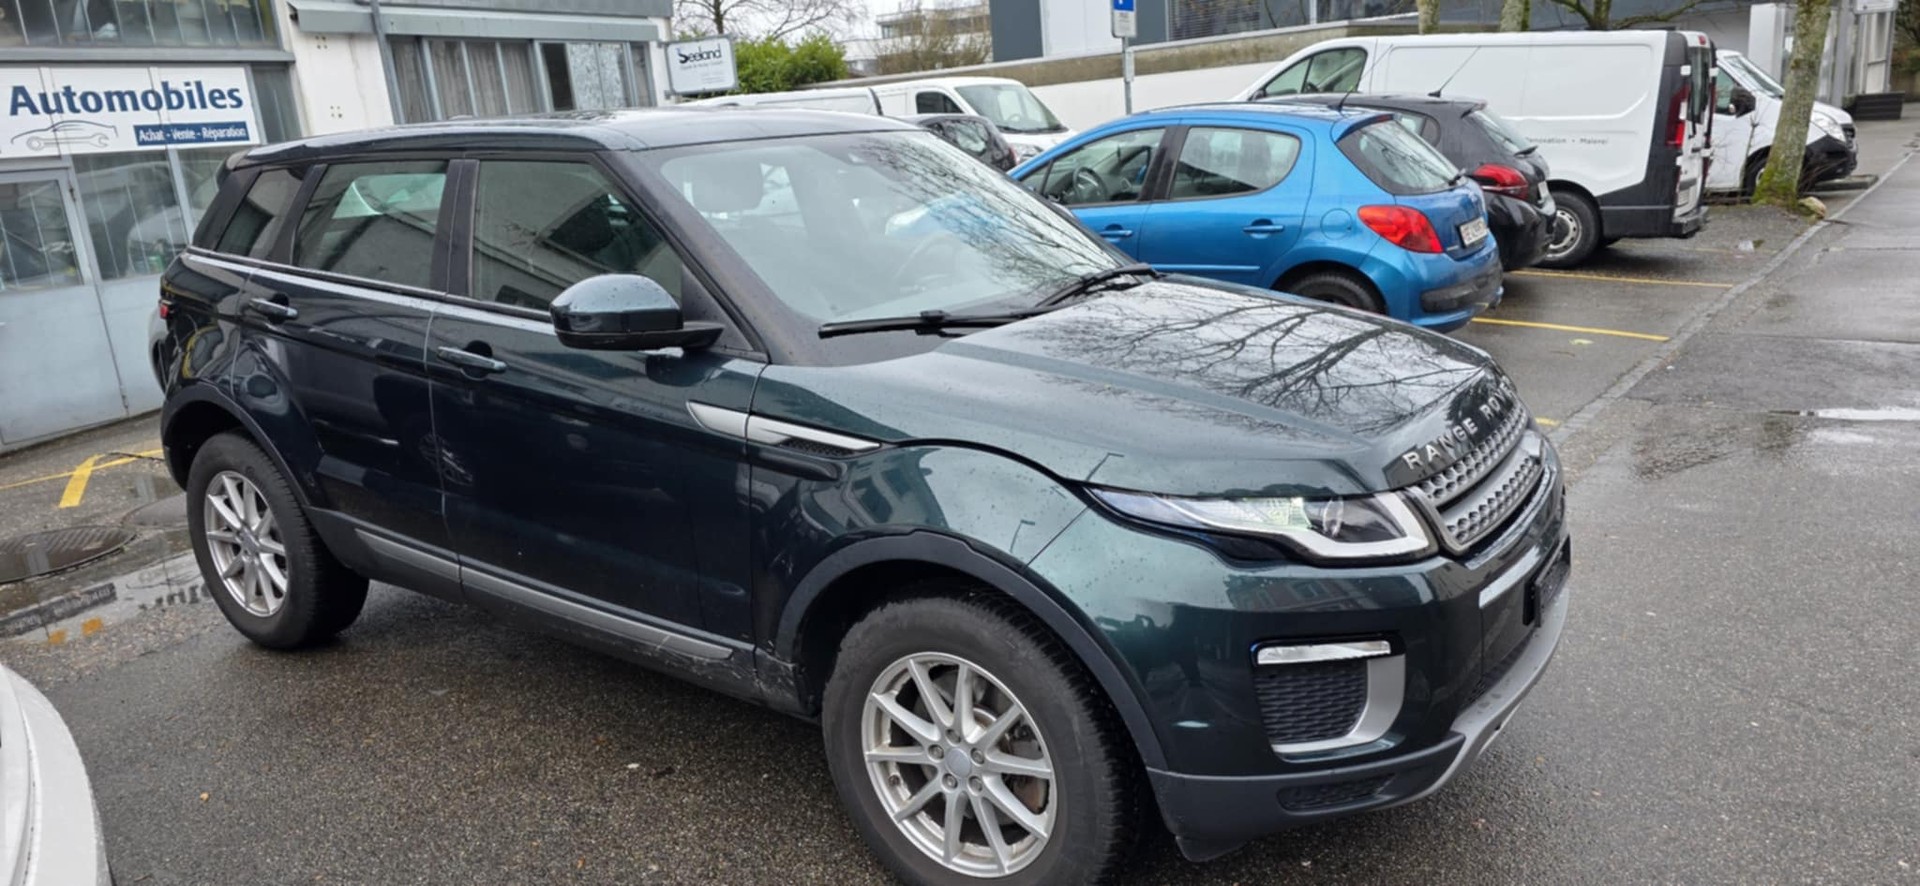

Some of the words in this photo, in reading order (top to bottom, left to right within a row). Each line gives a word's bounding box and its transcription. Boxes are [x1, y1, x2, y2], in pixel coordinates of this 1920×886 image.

[675, 43, 722, 64] Seeland
[9, 80, 243, 116] Automobiles
[139, 128, 164, 142] Achat
[171, 127, 196, 140] Vente
[201, 125, 246, 142] Réparation
[1525, 136, 1567, 144] enovation
[1402, 417, 1478, 470] RANGE
